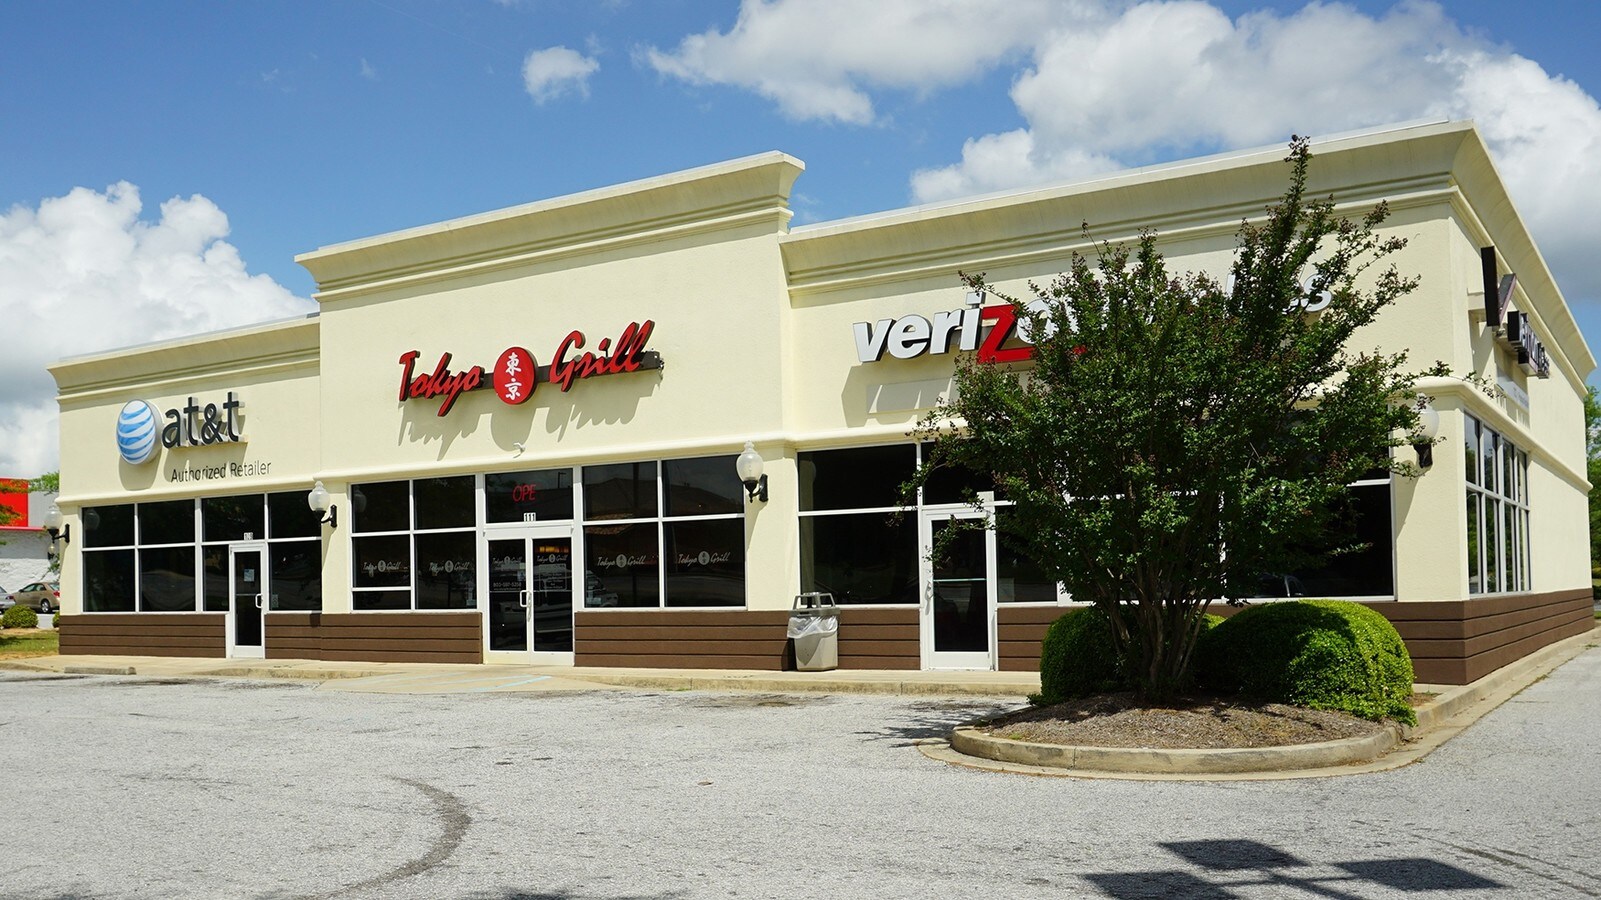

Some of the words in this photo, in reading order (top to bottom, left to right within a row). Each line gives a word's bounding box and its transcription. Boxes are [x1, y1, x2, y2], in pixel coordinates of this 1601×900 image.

[399, 350, 484, 417] Tokyo
[549, 319, 655, 392] Grill
[504, 351, 523, 401] 東京
[161, 391, 243, 449] at&t
[171, 463, 227, 483] Authorized
[230, 460, 272, 478] Retailer
[524, 513, 536, 522] 111
[597, 556, 616, 569] Tokyo
[626, 554, 646, 566] Grill
[678, 553, 698, 567] Tokyo
[710, 551, 731, 563] Grill
